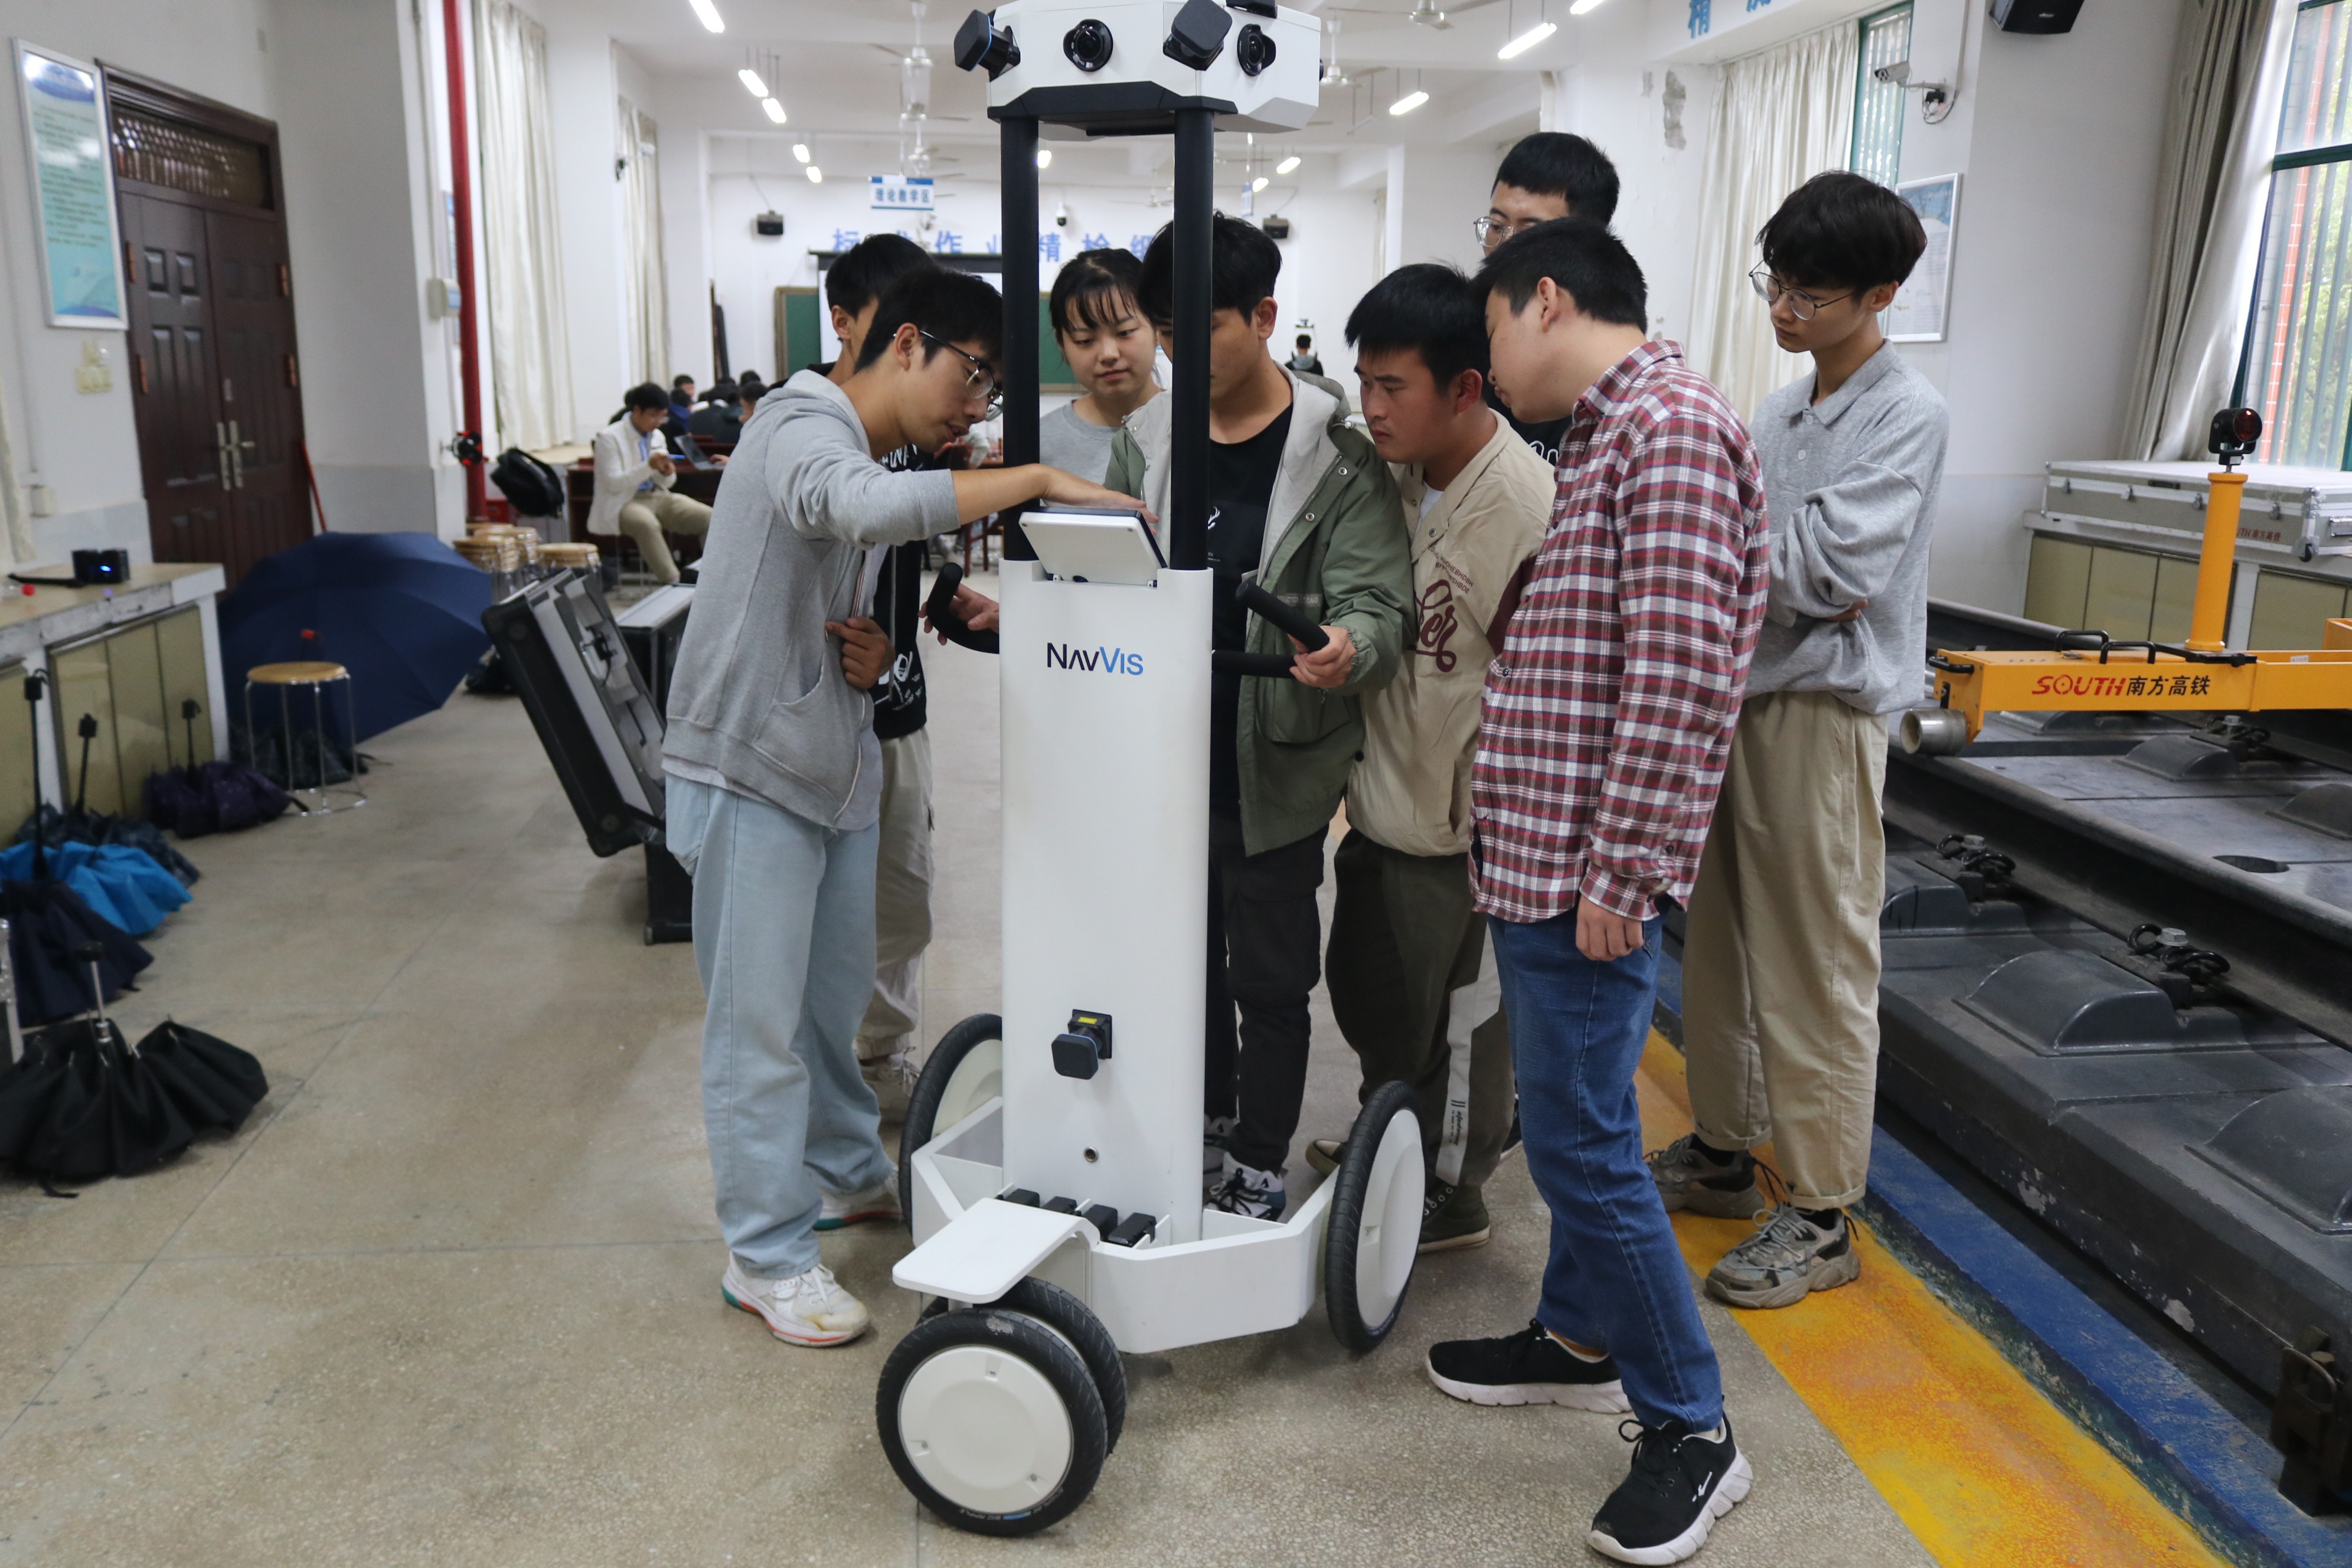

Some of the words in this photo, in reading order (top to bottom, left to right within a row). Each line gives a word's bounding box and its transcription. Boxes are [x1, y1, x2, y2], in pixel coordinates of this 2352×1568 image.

[2031, 674, 2126, 696] SOUTH
[2126, 675, 2210, 696] 南方高铁
